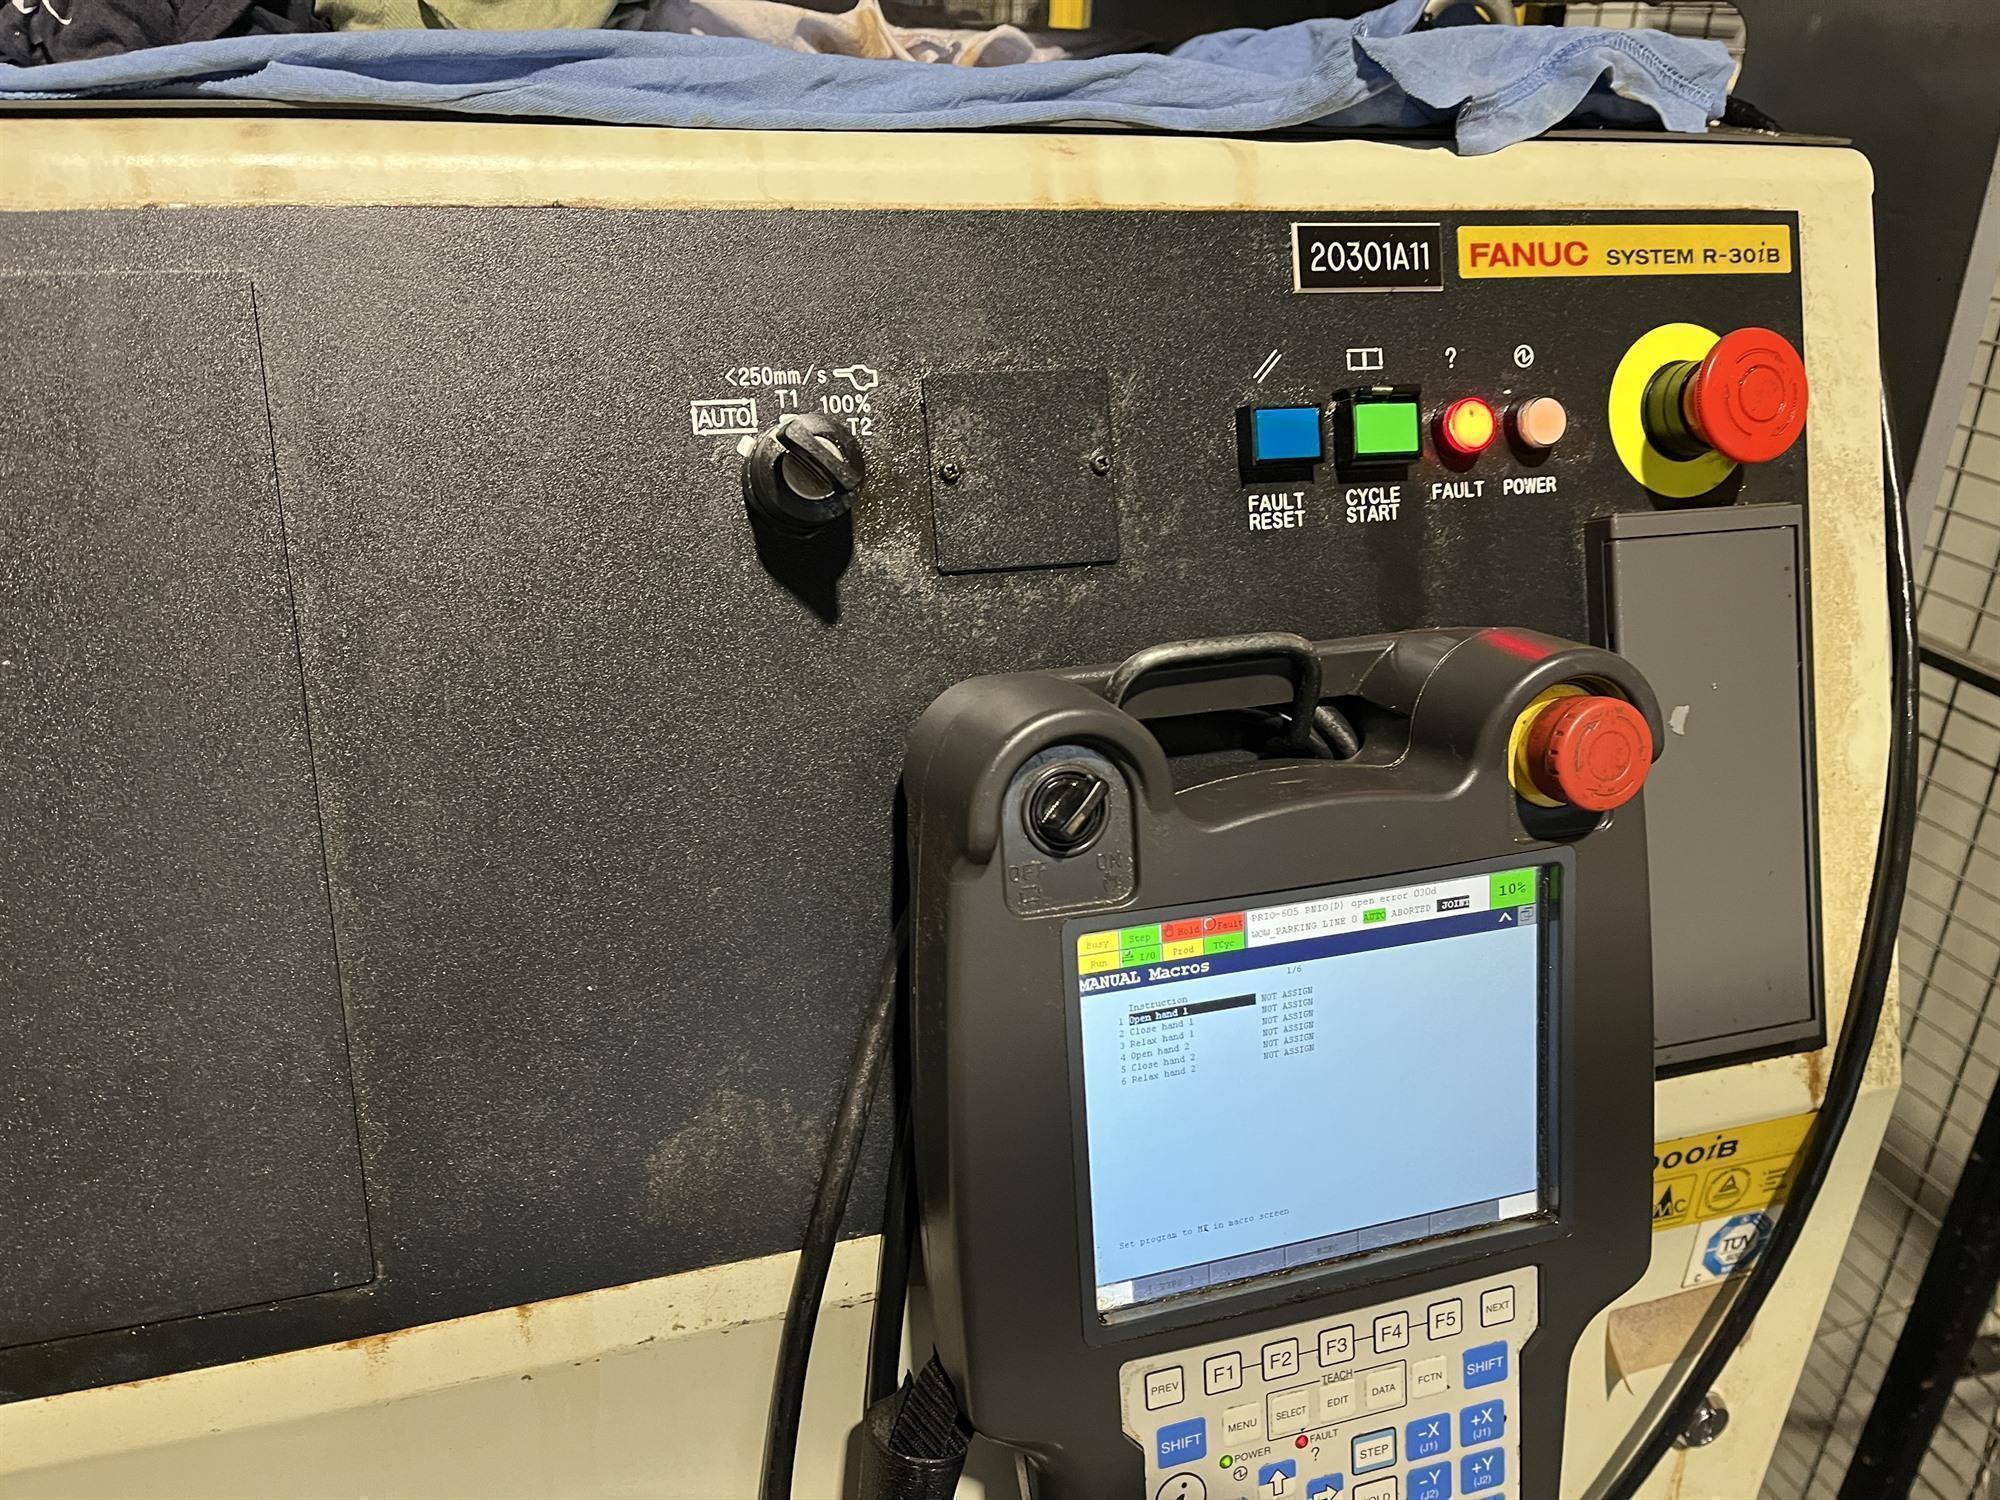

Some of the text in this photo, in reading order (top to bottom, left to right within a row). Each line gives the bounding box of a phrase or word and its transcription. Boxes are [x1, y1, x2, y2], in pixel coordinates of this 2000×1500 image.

[1310, 241, 1430, 272] 20301A11
[1470, 241, 1780, 267] FANUC SYSTEM R-30iB
[724, 364, 827, 386] <250mm/s
[774, 389, 798, 409] T1
[820, 395, 871, 414] 100%
[698, 406, 750, 428] AUTO
[846, 417, 873, 436] T2
[1431, 480, 1485, 500] FAULT
[1503, 476, 1558, 496] POWER
[1248, 492, 1305, 512] FAULT
[1345, 486, 1401, 507] CYCLE
[1249, 510, 1305, 531] RESET
[1346, 504, 1400, 524] START
[1499, 882, 1527, 897] 10%
[1251, 909, 1299, 922] PRIO-605
[1351, 899, 1375, 909] open
[1380, 893, 1408, 903] error
[1322, 917, 1346, 929] LINE
[1363, 909, 1387, 923] AUTO
[1391, 904, 1431, 917] ABORTED
[1177, 926, 1200, 936] Hold
[1217, 920, 1243, 930] Fault
[1129, 934, 1151, 943] Step
[1139, 952, 1156, 961] I/O
[1173, 946, 1194, 956] Prod
[1090, 960, 1108, 969] Run
[1079, 961, 1210, 992] MANUAL Macros
[1129, 997, 1189, 1012] Instruction
[1129, 1015, 1152, 1025] Open
[1155, 1009, 1178, 1019] hand
[1261, 992, 1278, 1002] NOT
[1282, 986, 1313, 998] ASSIGN
[1130, 1026, 1157, 1036] Close
[1162, 1020, 1184, 1031] hand
[1261, 1003, 1278, 1014] NOT
[1282, 997, 1313, 1010] ASSIGN
[1130, 1038, 1158, 1048] Relax
[1162, 1032, 1185, 1043] hand
[1262, 1015, 1279, 1025] NOT
[1282, 1009, 1314, 1022] ASSIGN
[1130, 1050, 1153, 1061] Open
[1157, 1044, 1180, 1055] hand
[1262, 1027, 1279, 1037] NOT
[1283, 1020, 1314, 1033] ASSIGN
[1131, 1061, 1159, 1072] Close
[1163, 1055, 1186, 1066] hand
[1263, 1038, 1279, 1048] NOT
[1283, 1032, 1315, 1045] ASSIGN
[1131, 1072, 1160, 1084] Relax
[1164, 1067, 1186, 1078] hand
[1263, 1050, 1280, 1060] NOT
[1284, 1044, 1315, 1056] ASSIGN
[1119, 1241, 1136, 1250] Set
[1140, 1233, 1178, 1248] program
[1182, 1228, 1193, 1236] to
[1213, 1222, 1224, 1230] in
[1227, 1214, 1255, 1227] macro
[1259, 1208, 1290, 1220] screen
[1486, 1300, 1511, 1314] NEXT
[1435, 1311, 1456, 1329] F5
[1381, 1324, 1403, 1343] F4
[1326, 1338, 1348, 1356] F3
[1270, 1351, 1292, 1370] F2
[1466, 1356, 1504, 1376] SHIFT
[1214, 1365, 1233, 1384] F1
[1321, 1369, 1353, 1386] TEACH
[1417, 1371, 1443, 1385] FCTN
[1151, 1381, 1179, 1396] PREV
[1372, 1383, 1396, 1397] DATA
[1327, 1395, 1349, 1408] EDIT
[1276, 1405, 1307, 1421] SELECT
[1470, 1408, 1493, 1427] +X
[1228, 1418, 1257, 1433] MENU
[1418, 1421, 1440, 1438] -X
[1473, 1427, 1492, 1441] (J1)
[1160, 1433, 1203, 1455] SHIFT
[1309, 1428, 1339, 1443] FAULT
[1234, 1446, 1272, 1463] POWER
[1359, 1443, 1390, 1460] STEP
[1419, 1440, 1439, 1455] (J1)
[1471, 1455, 1494, 1474] +Y
[1418, 1469, 1441, 1485] -Y
[1473, 1475, 1492, 1488] (J2)
[1420, 1488, 1439, 1500] (J2)
